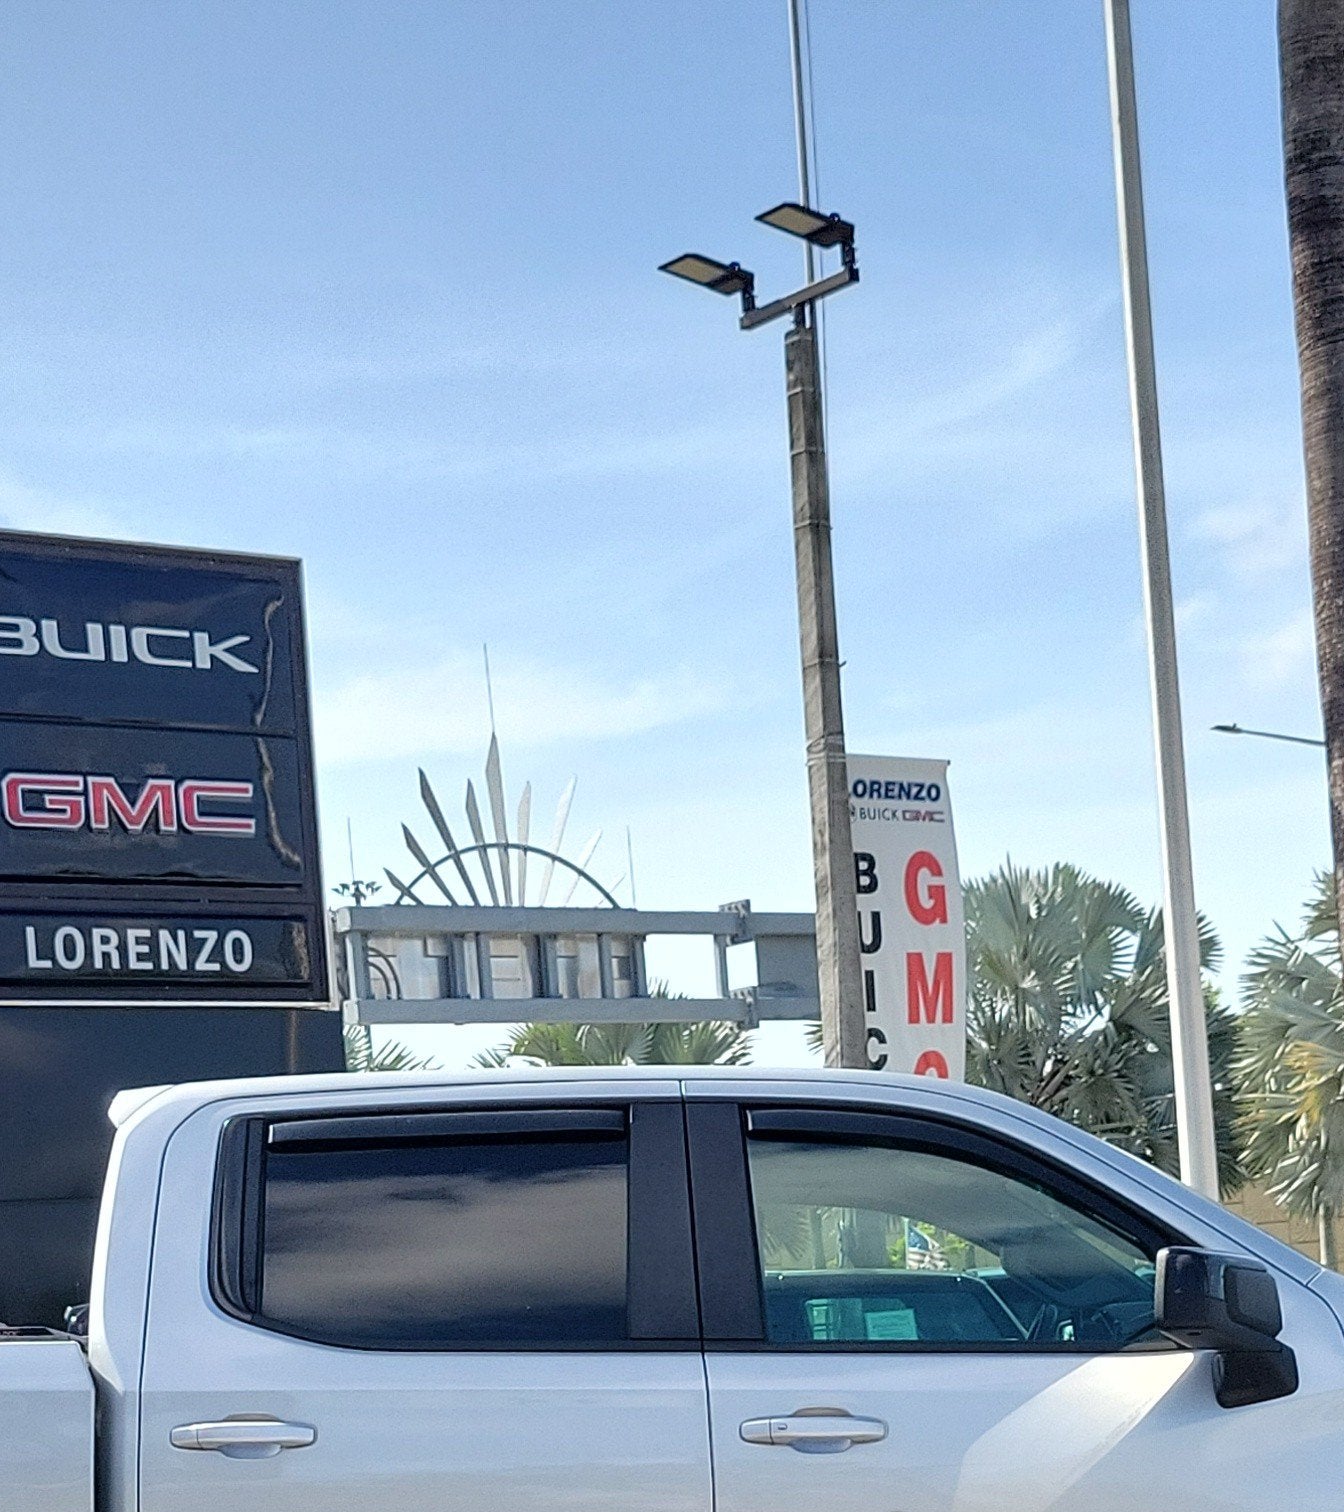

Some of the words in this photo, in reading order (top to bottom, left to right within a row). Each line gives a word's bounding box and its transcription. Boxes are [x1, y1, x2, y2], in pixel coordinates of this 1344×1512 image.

[0, 771, 255, 835] GMC
[849, 779, 941, 803] ORENZO
[859, 807, 899, 822] BUICK
[24, 924, 253, 973] LORENZO
